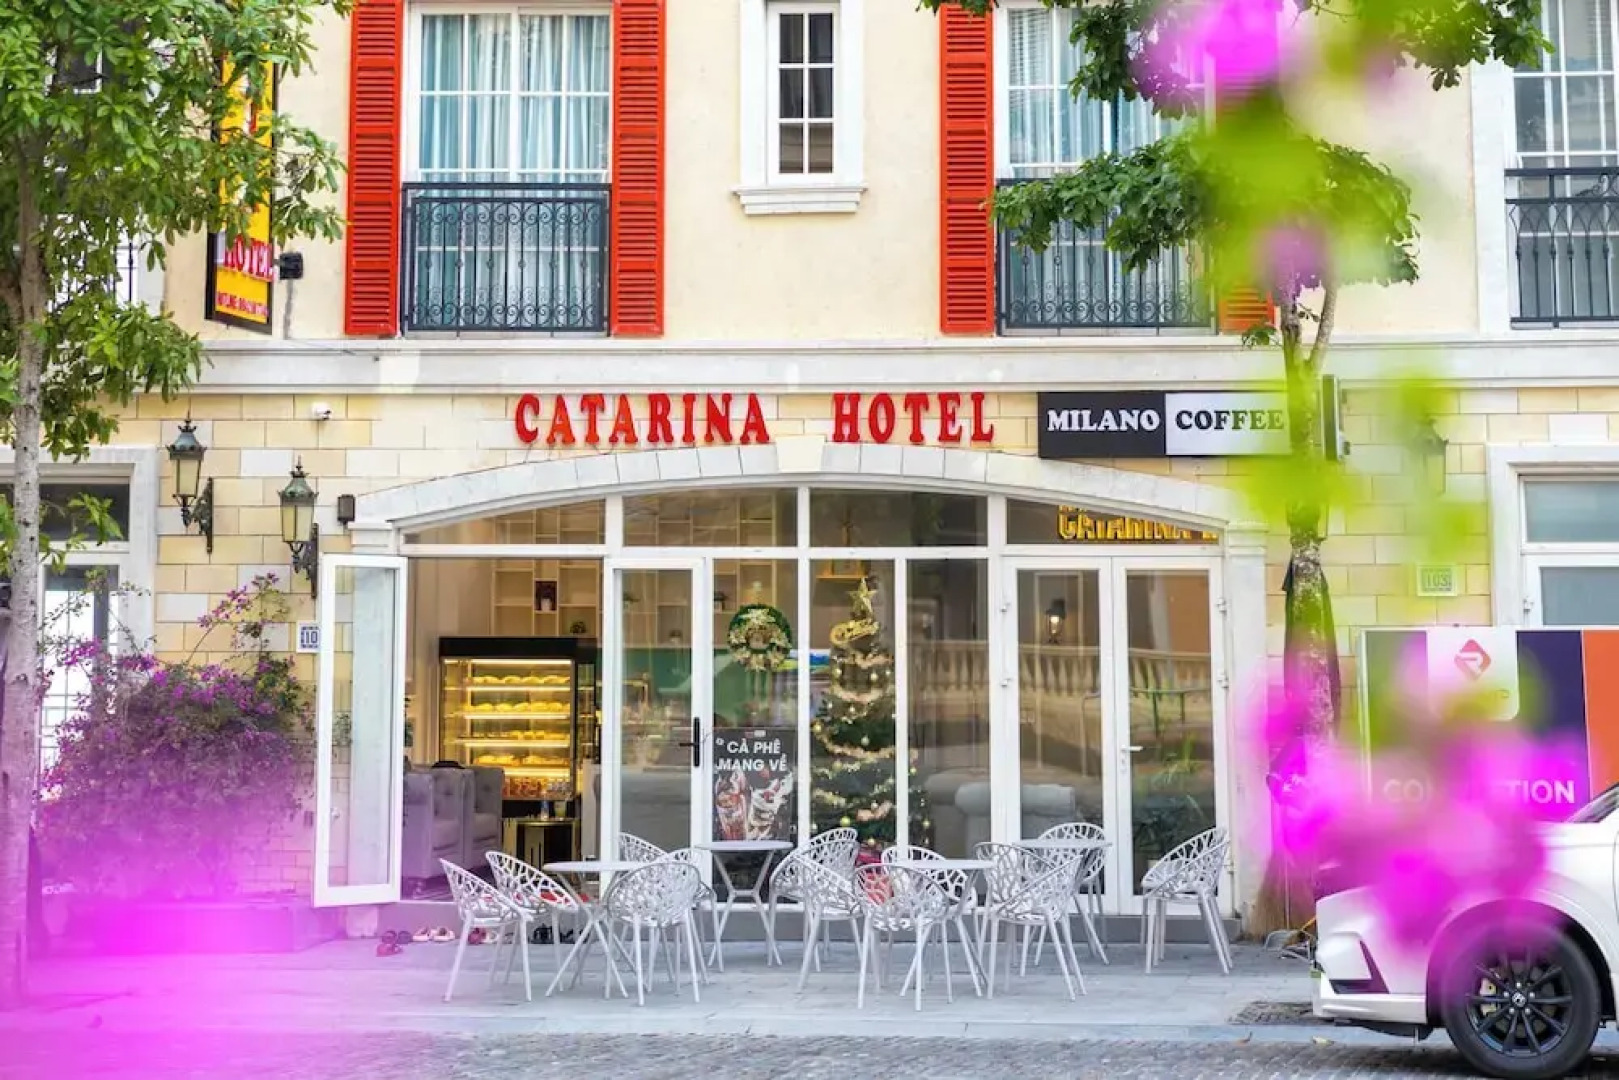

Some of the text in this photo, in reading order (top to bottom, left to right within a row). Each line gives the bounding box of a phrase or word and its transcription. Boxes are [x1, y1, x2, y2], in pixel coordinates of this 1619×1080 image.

[515, 392, 994, 445] CATARINA HOTEL
[1047, 409, 1285, 431] MILANO COFFEE
[1058, 504, 1193, 540] CATARI
[753, 738, 781, 754] PHÊ
[717, 757, 765, 772] MANG
[1383, 778, 1575, 805] COTION
